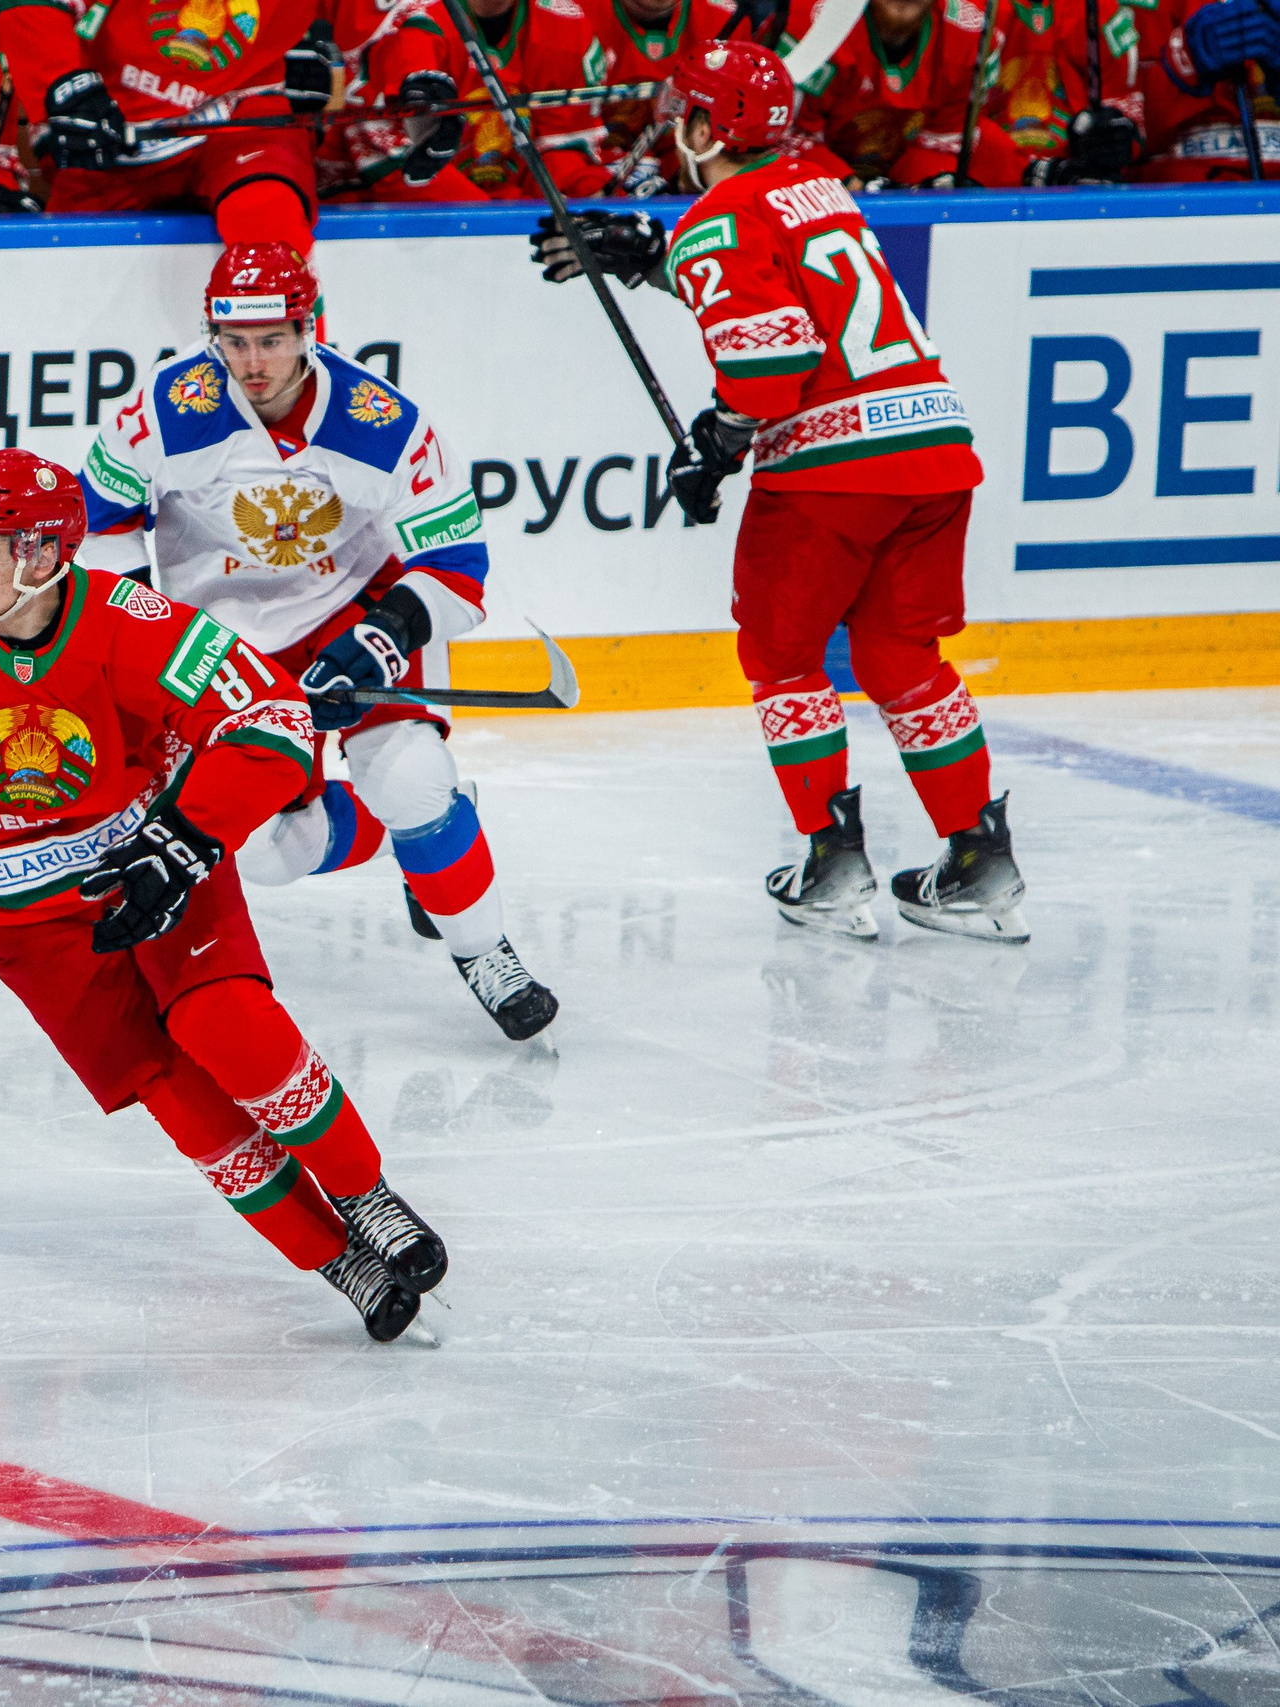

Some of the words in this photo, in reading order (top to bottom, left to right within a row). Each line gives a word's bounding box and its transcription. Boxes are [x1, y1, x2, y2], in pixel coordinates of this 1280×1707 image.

[767, 105, 789, 126] 22
[231, 268, 263, 286] 27
[1023, 329, 1280, 502] BE
[34, 518, 64, 529] CCM
[420, 530, 449, 550] ЛИГА
[187, 654, 218, 689] ЛИГА
[209, 641, 277, 712] 81
[10, 791, 52, 804] БЕЛАРУСЬ
[142, 822, 210, 885] CCM
